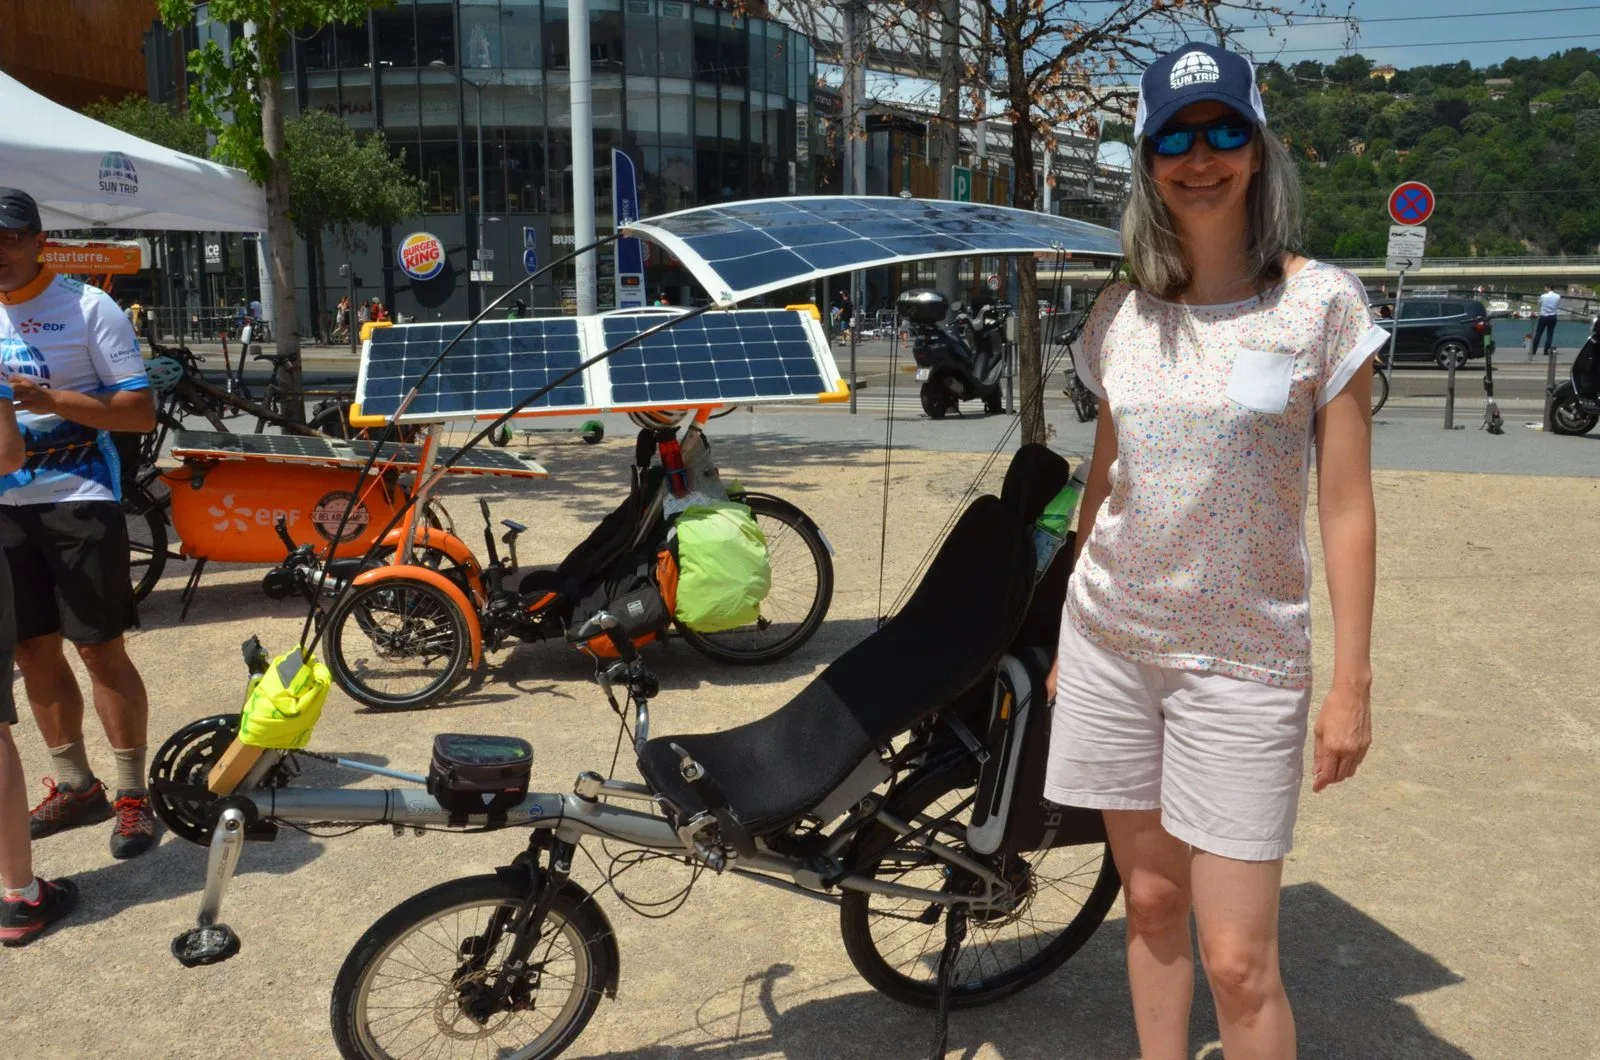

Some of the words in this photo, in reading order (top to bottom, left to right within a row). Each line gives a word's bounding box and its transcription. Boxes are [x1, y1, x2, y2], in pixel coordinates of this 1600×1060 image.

[1170, 74, 1193, 87] SUN
[1194, 72, 1220, 81] TRIP
[99, 181, 117, 193] SUN
[119, 182, 139, 195] TRIP
[958, 175, 967, 201] P
[205, 240, 220, 257] ice
[403, 240, 437, 259] BURGER
[405, 248, 440, 272] KING
[318, 512, 330, 521] BEL
